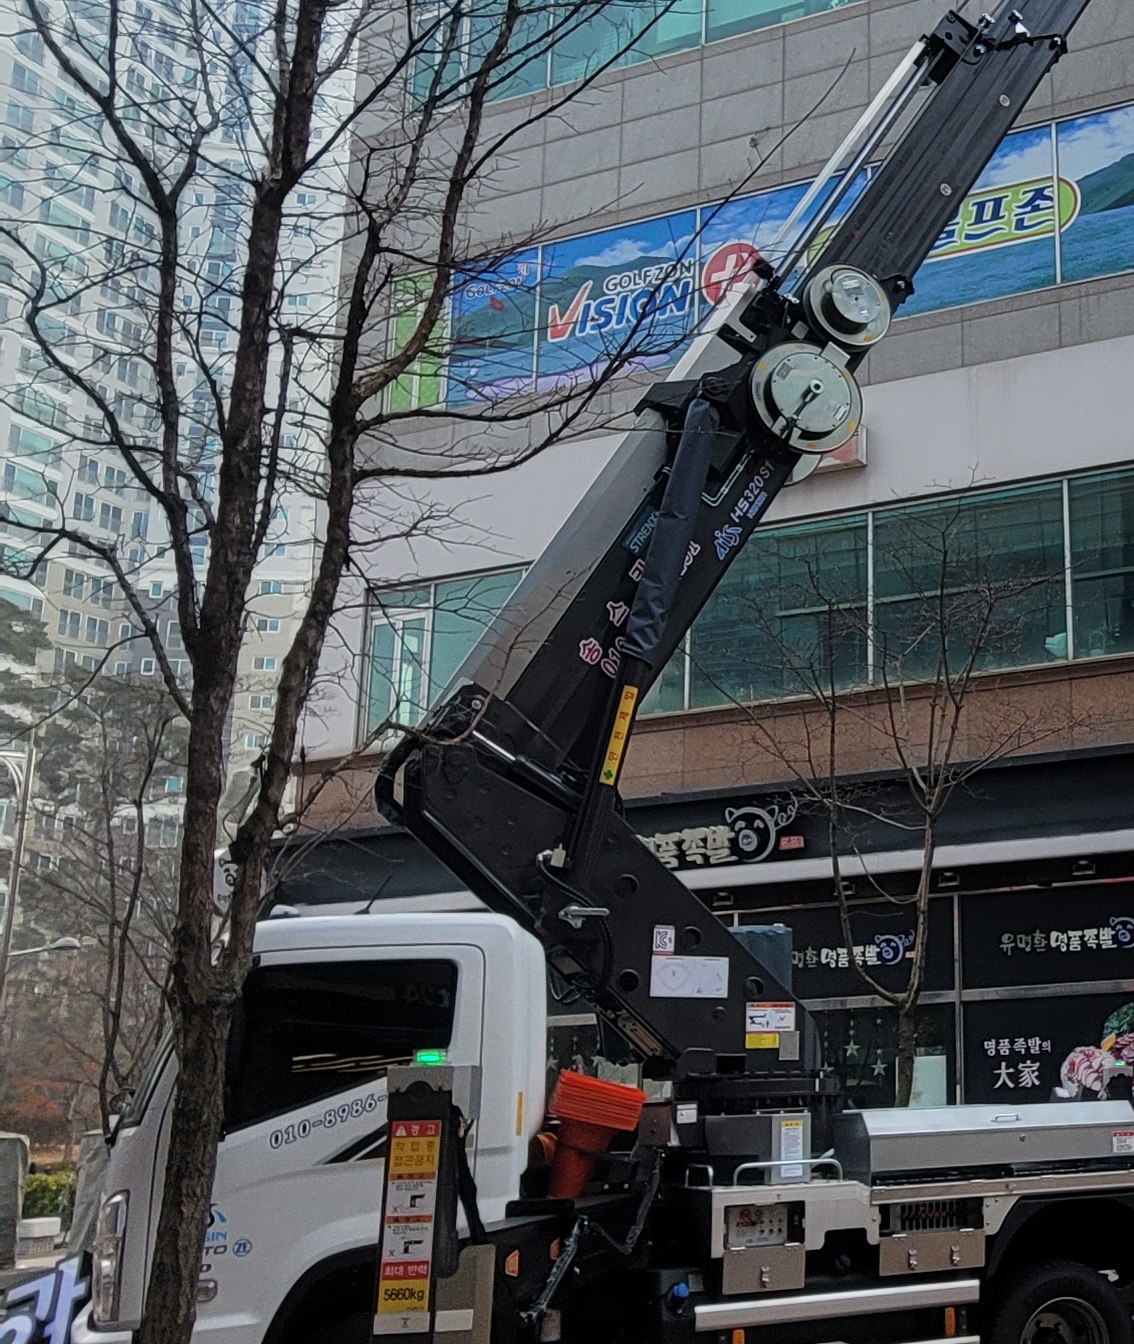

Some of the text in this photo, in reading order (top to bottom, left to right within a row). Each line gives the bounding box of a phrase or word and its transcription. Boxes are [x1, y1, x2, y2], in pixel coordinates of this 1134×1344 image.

[604, 259, 694, 295] GOLFZON
[992, 1059, 1041, 1089] 大家
[382, 1287, 425, 1302] 5660kg
